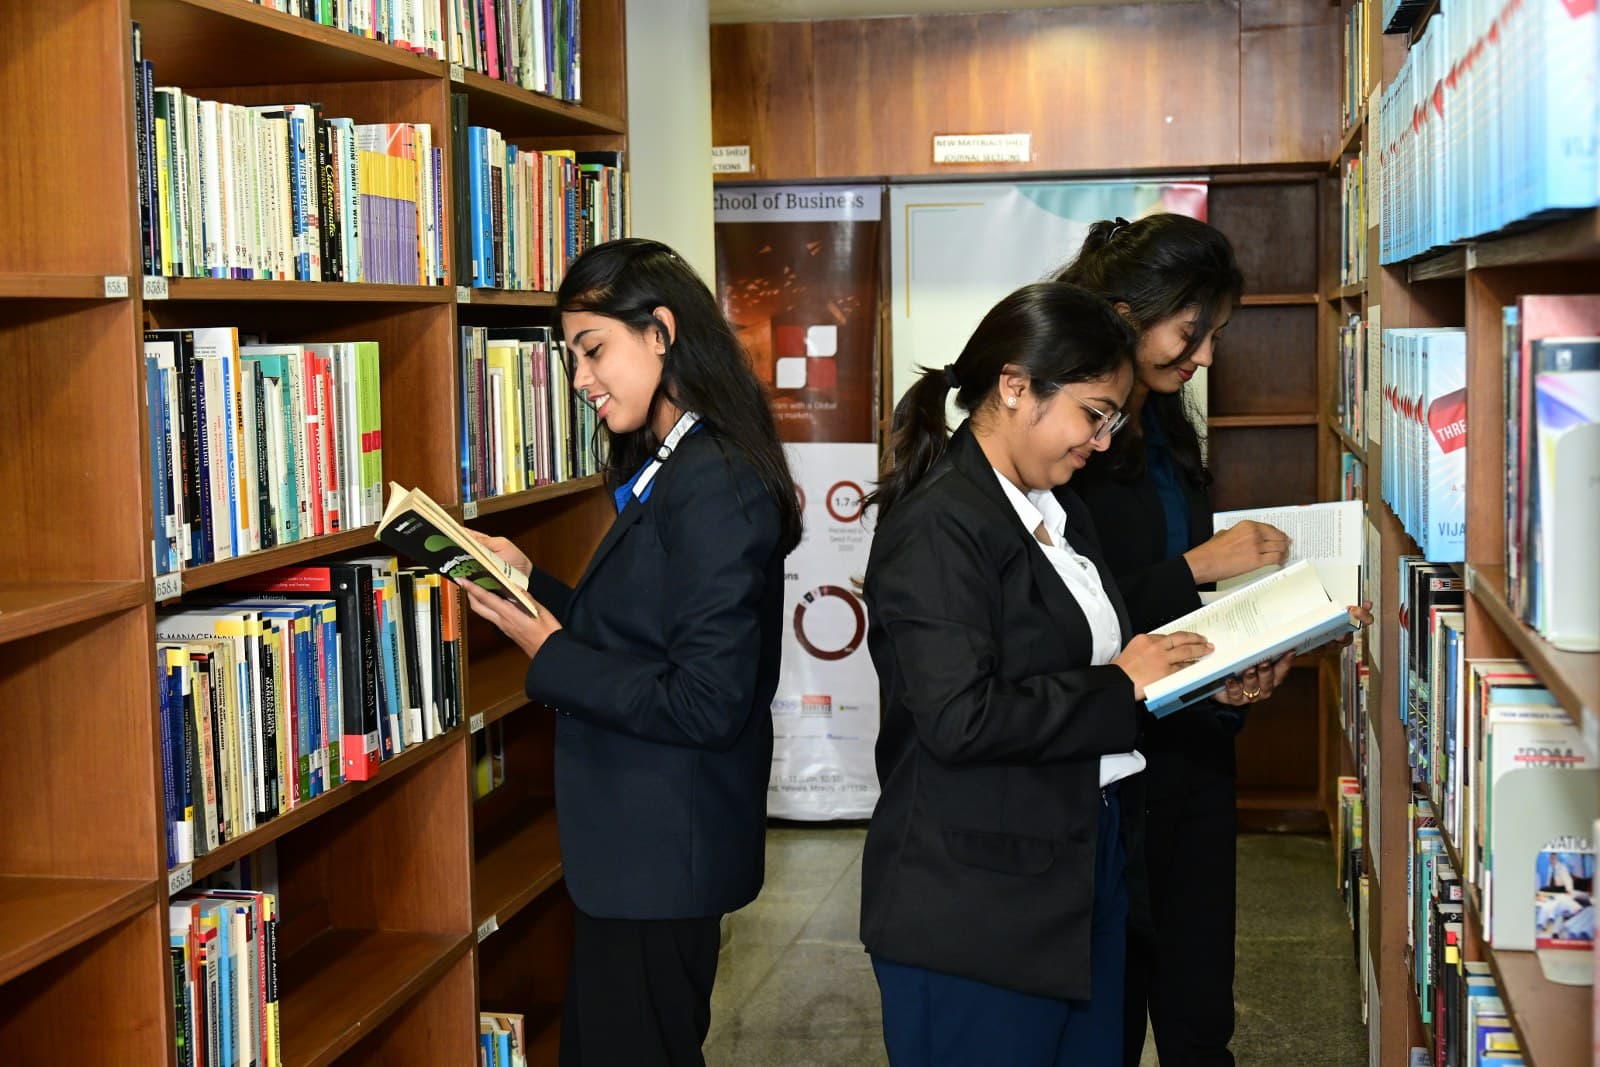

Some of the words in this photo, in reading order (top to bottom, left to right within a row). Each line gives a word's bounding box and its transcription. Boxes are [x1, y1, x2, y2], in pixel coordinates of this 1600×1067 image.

[147, 69, 155, 132] INTERNATIONAL
[150, 133, 158, 192] MANAGEMENT
[300, 187, 308, 223] SPARKS
[325, 164, 337, 239] Culturematic
[352, 196, 357, 206] TO
[764, 192, 782, 210] of
[190, 357, 201, 497] ENTREPRENEURSHIP
[814, 400, 837, 409] Global
[166, 432, 174, 480] RENEWAL
[201, 423, 209, 468] Ambition
[227, 418, 235, 455] Dollar
[157, 578, 178, 597] 658.4
[265, 676, 273, 738] MANAGEMENT
